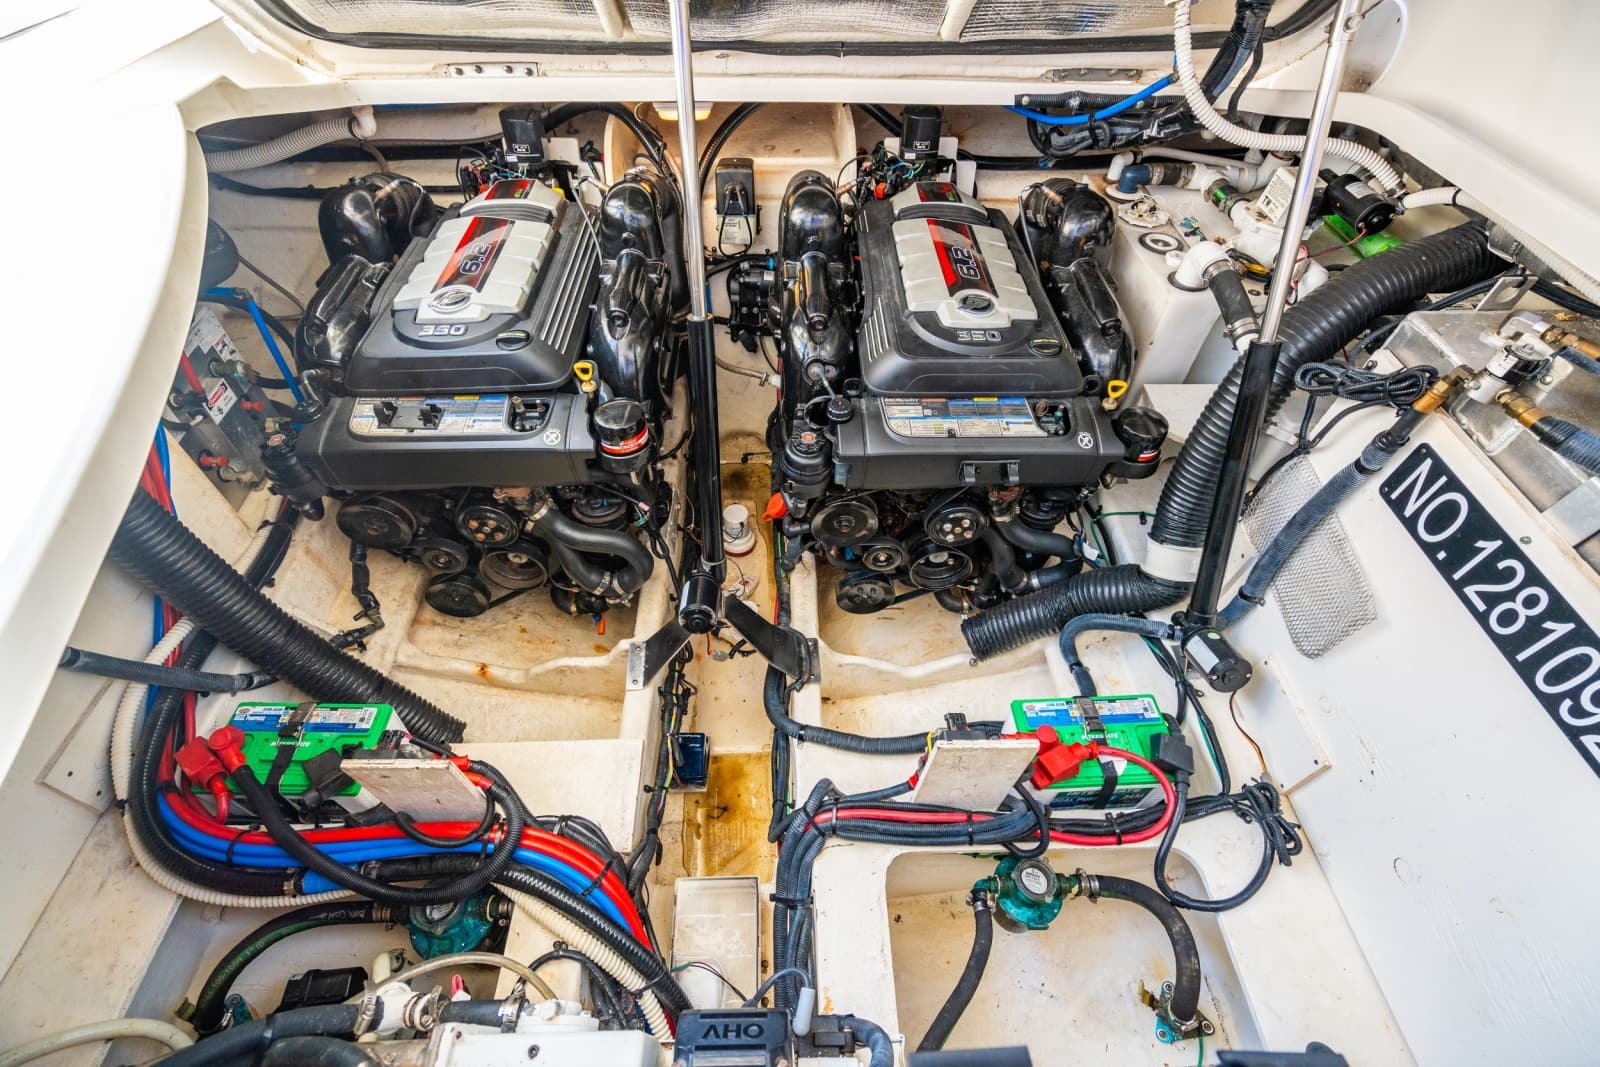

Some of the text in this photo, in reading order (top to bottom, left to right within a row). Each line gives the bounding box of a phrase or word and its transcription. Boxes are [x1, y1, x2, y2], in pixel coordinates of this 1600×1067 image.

[459, 243, 492, 276] 6.2
[951, 246, 981, 280] 6.2
[418, 324, 467, 338] 350
[956, 330, 1002, 342] 350
[702, 1024, 764, 1040] OHV
